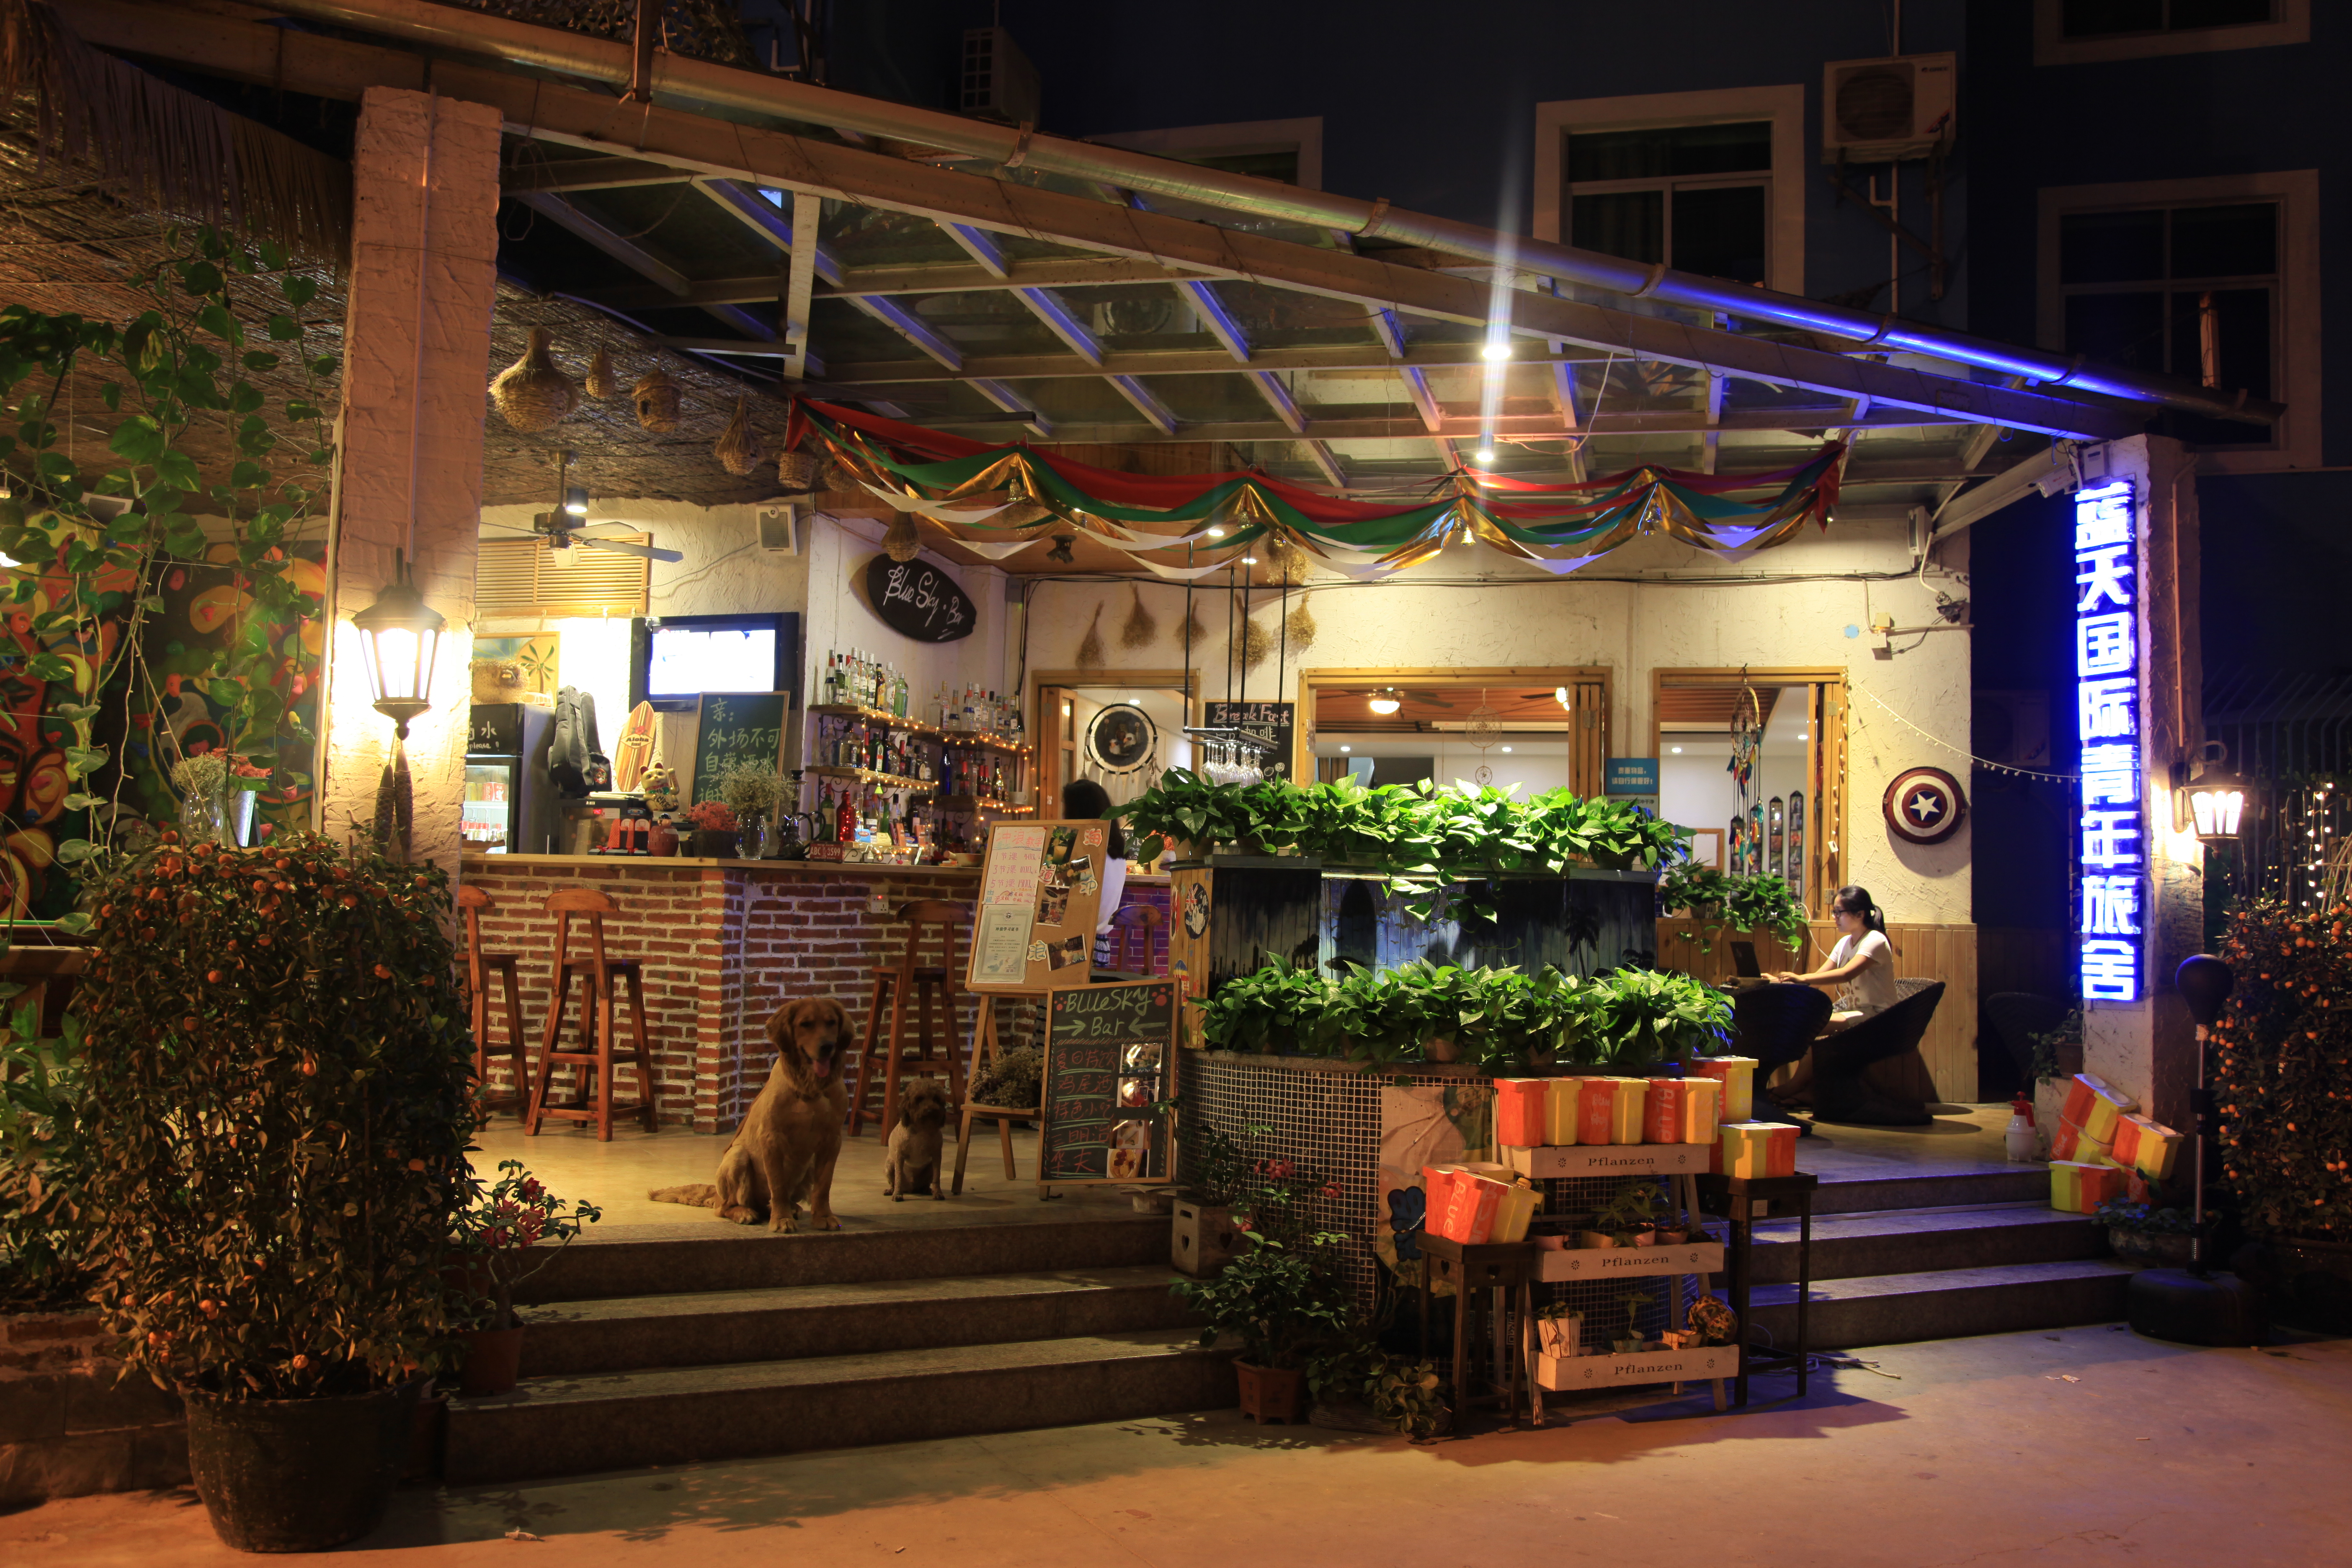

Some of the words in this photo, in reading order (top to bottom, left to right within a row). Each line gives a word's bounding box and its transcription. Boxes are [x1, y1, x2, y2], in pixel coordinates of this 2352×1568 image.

[883, 565, 914, 606] Blue
[916, 571, 939, 627] Sky
[946, 596, 965, 625] Bar
[708, 728, 781, 749] 外场不可
[2075, 481, 2135, 1001] 蓝天国际青年旅舍
[1091, 1016, 1125, 1037] Bar
[1056, 1048, 1117, 1071] 夏日特饮
[1057, 1075, 1114, 1095] 鸡尾酒
[1054, 1098, 1114, 1120] 特色小吃
[1588, 1157, 1655, 1166] Pflanzen
[1602, 1256, 1669, 1267] Pflanzen
[1615, 1363, 1683, 1375] Pflanzen
